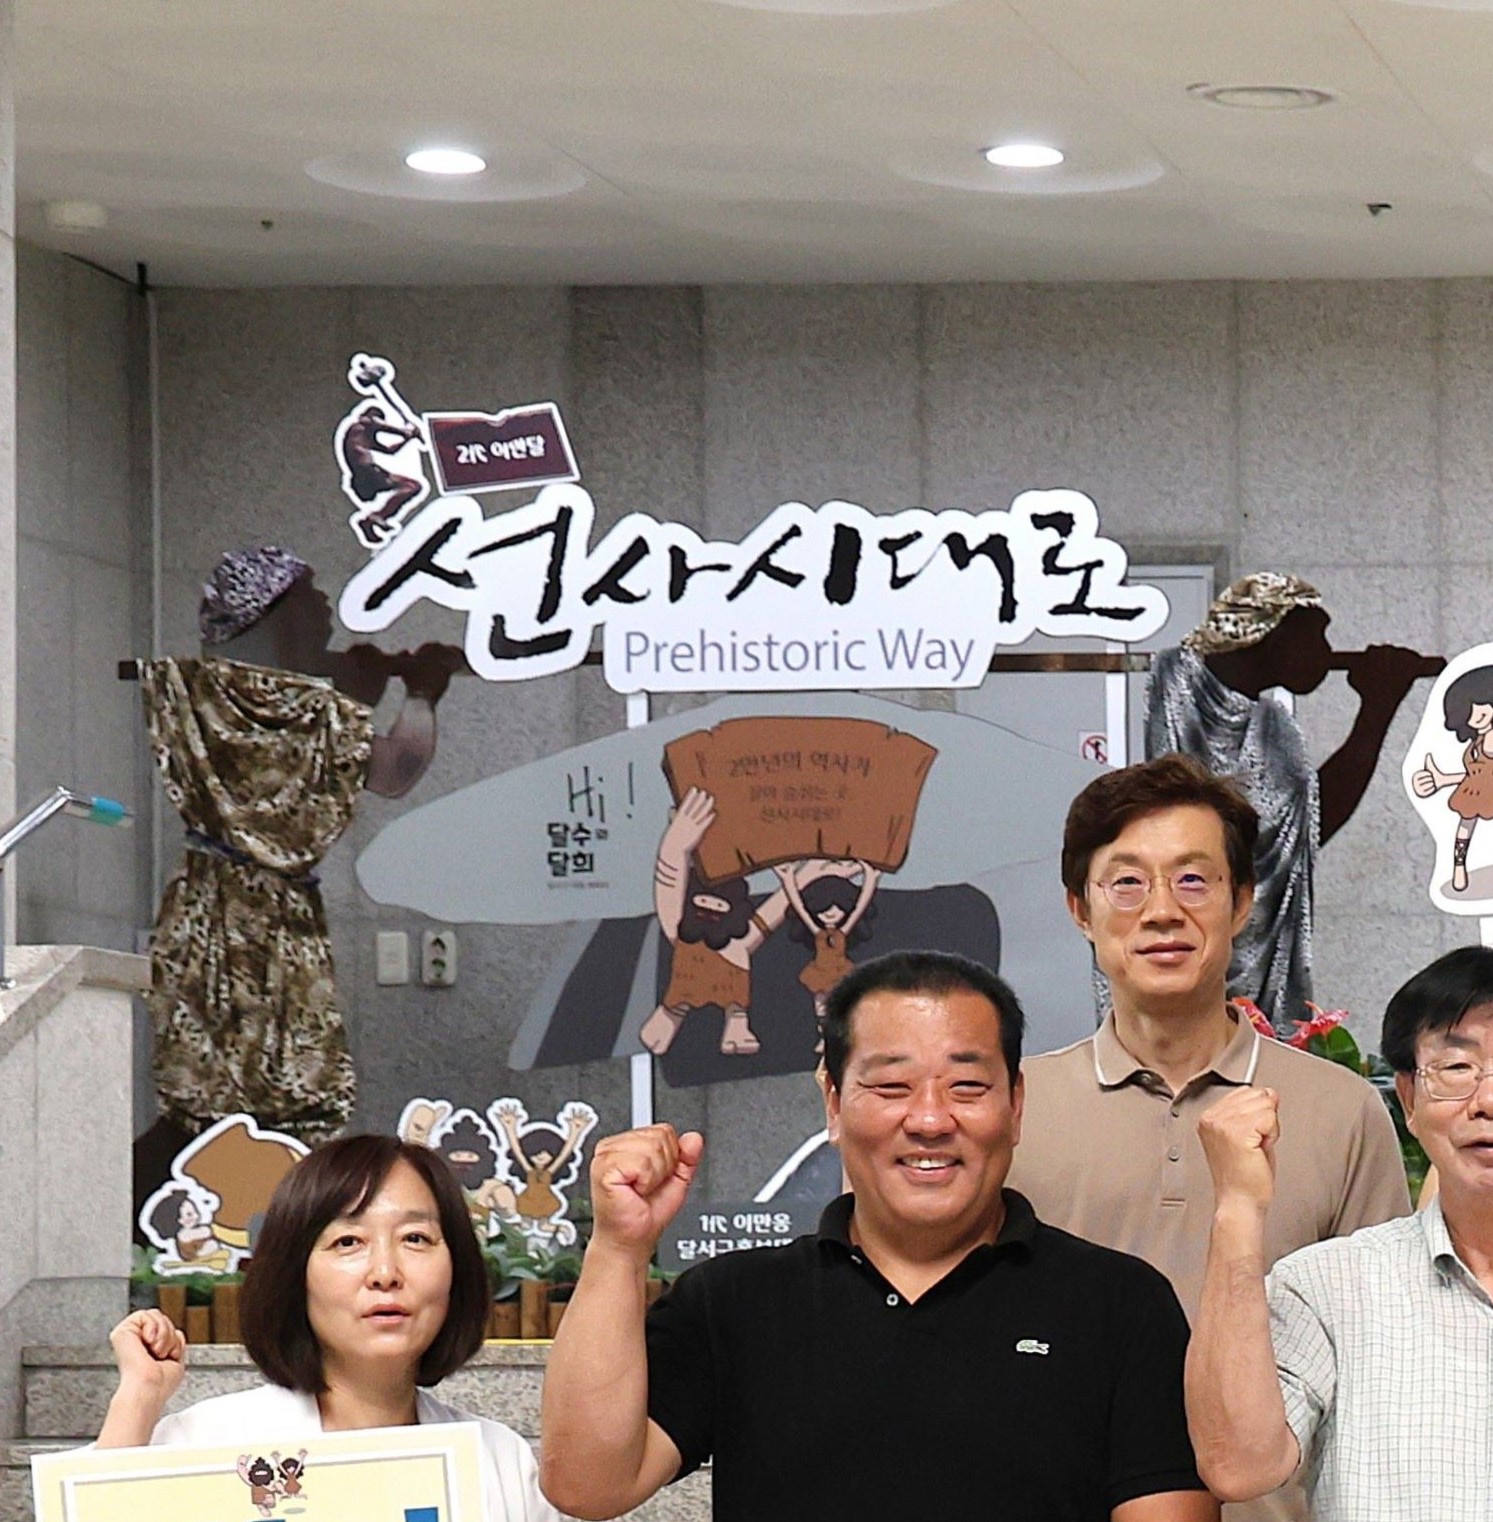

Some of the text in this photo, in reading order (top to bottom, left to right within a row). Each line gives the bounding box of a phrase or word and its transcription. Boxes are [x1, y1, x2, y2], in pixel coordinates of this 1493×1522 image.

[365, 504, 1145, 661] 선사시대로
[624, 628, 974, 682] Prehistoric Way
